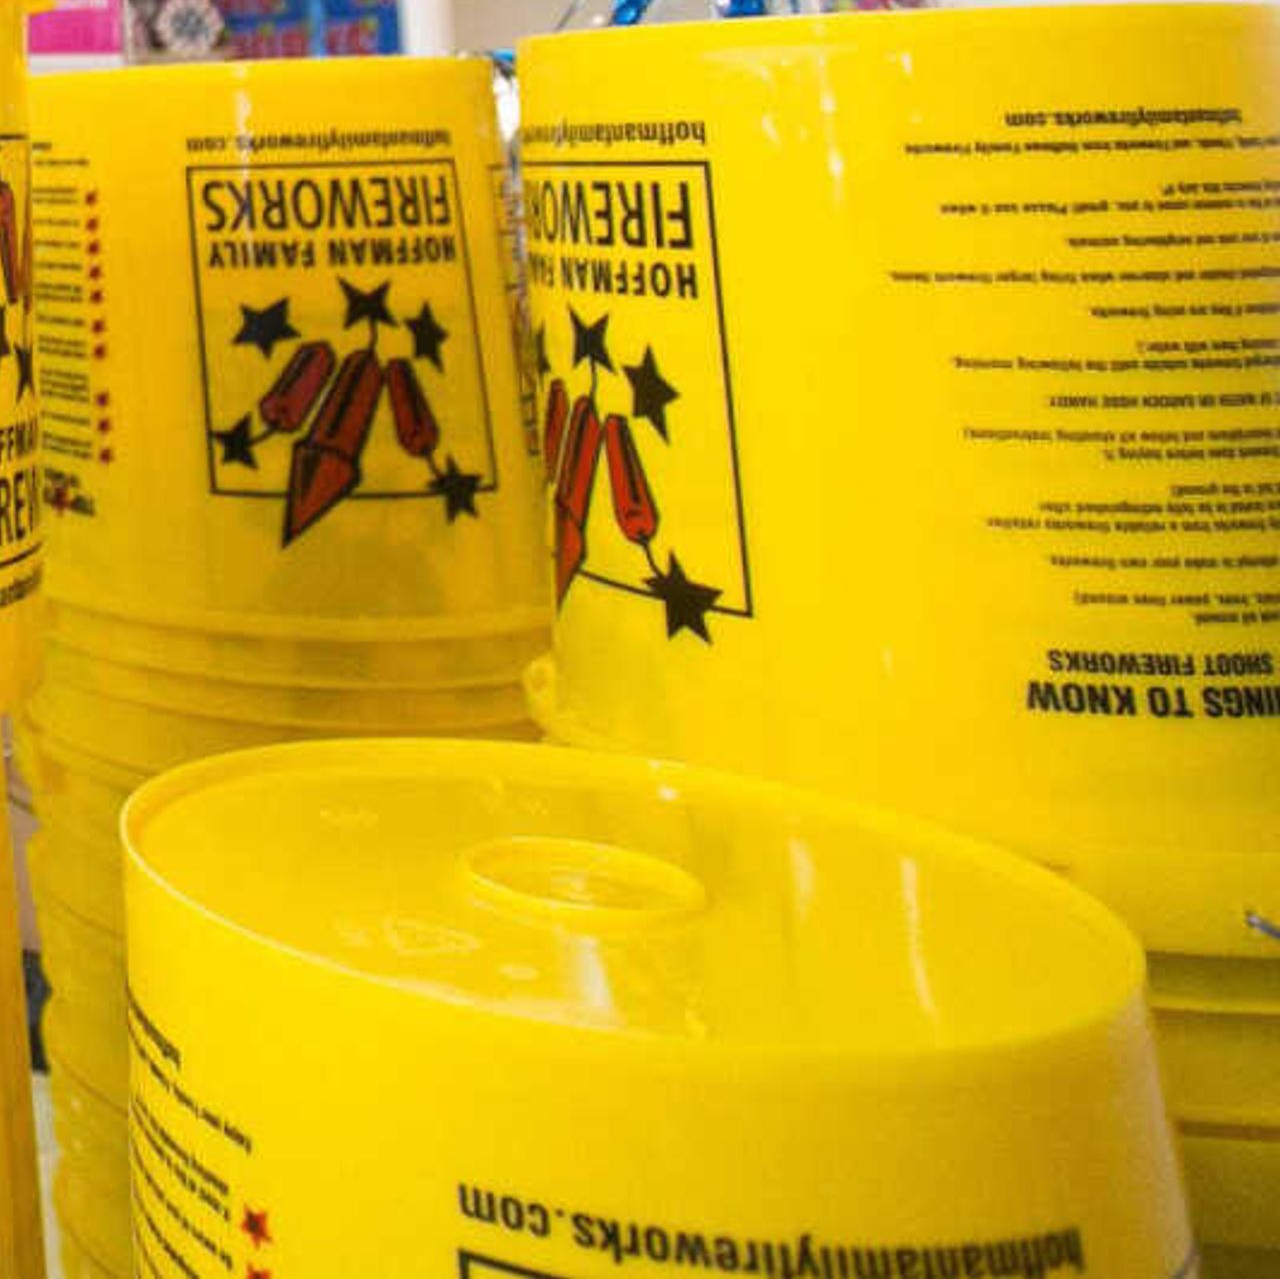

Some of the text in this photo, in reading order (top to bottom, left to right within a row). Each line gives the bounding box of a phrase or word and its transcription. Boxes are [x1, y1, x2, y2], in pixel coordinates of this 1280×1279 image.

[202, 175, 451, 232] FIREWORKS
[208, 238, 456, 269] HOFFMAN FAMILY
[561, 259, 698, 301] HOFFMAN
[1047, 650, 1273, 675] SHOOT FIREWORKS
[1027, 681, 1133, 715] KNOW
[1147, 686, 1192, 716] TO
[458, 1181, 1085, 1276] hoffmanfamilyfireworks.com
